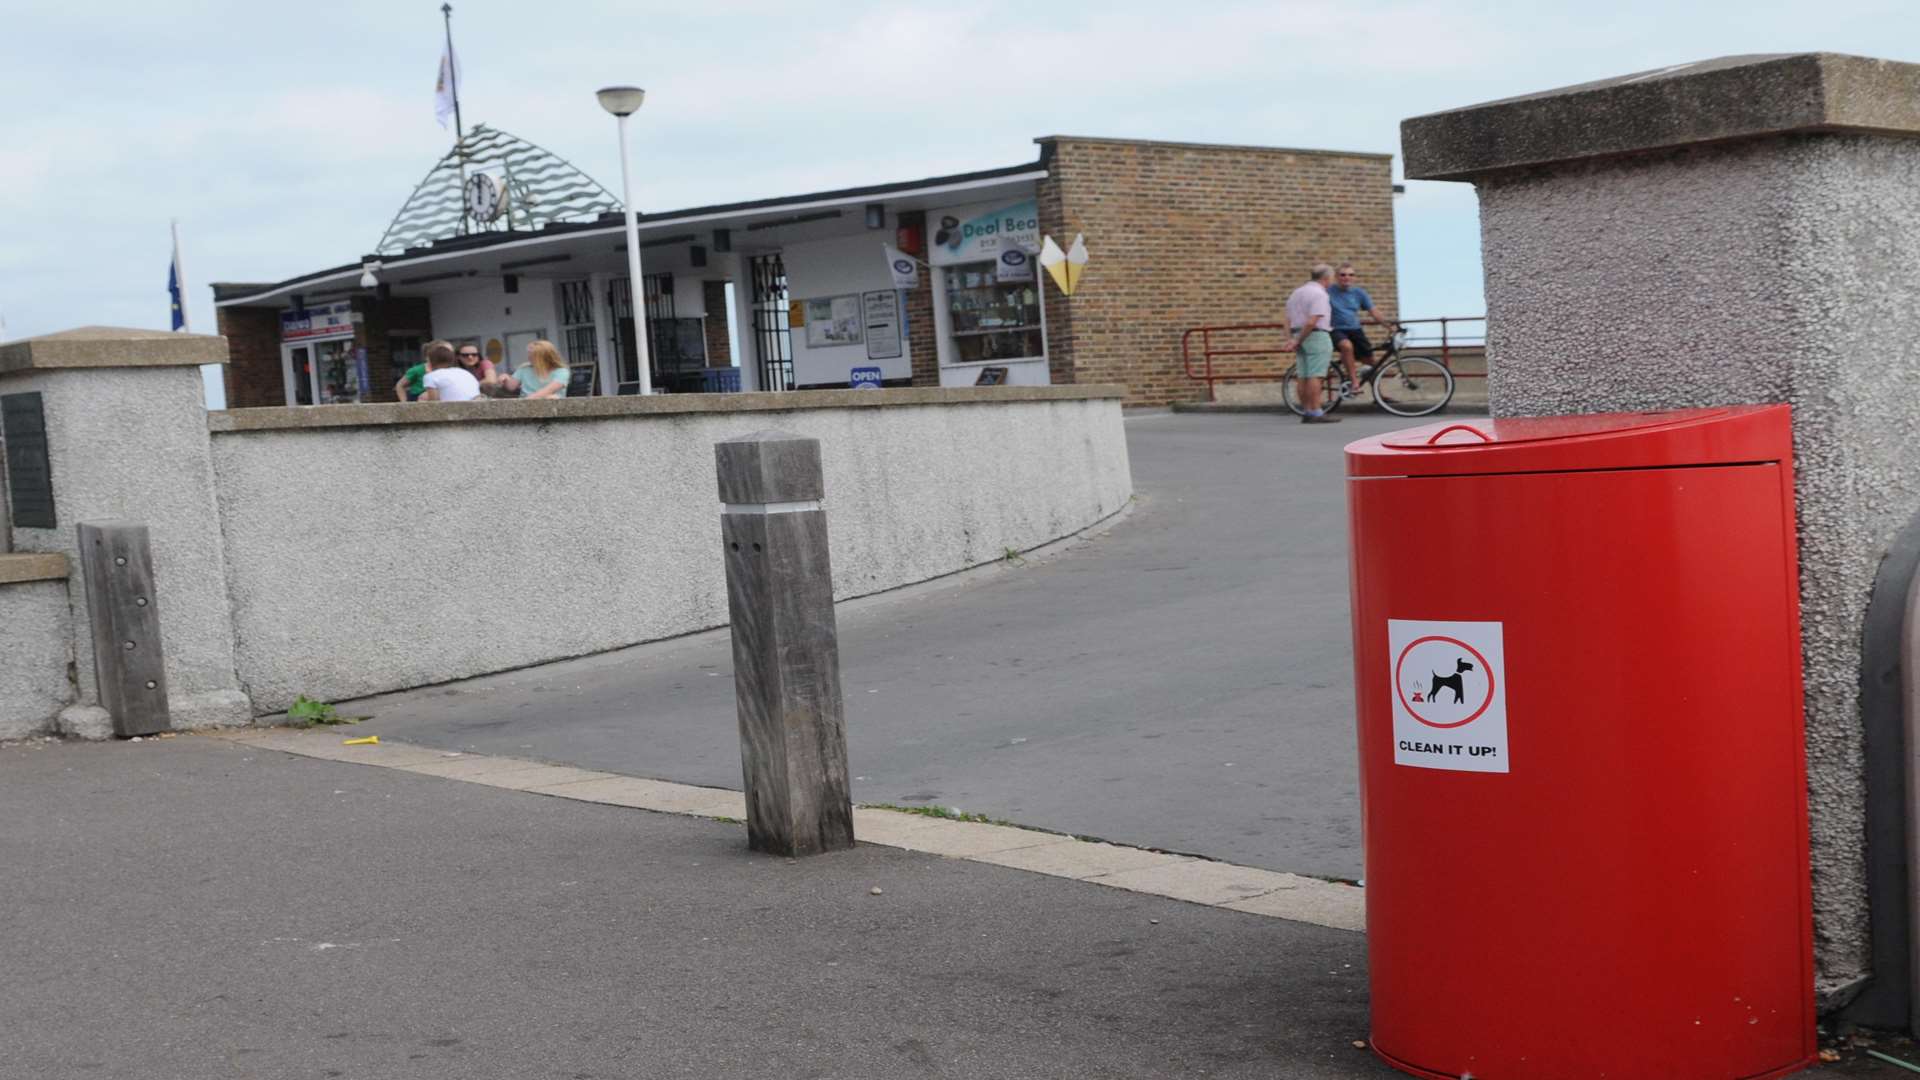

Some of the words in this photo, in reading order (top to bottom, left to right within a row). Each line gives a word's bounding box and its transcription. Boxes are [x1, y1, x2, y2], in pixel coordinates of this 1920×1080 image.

[963, 219, 1000, 238] Deal
[852, 371, 880, 381] OPEN
[1399, 740, 1443, 754] CLEAN
[1448, 744, 1463, 755] IT
[1469, 746, 1497, 757] UP!
